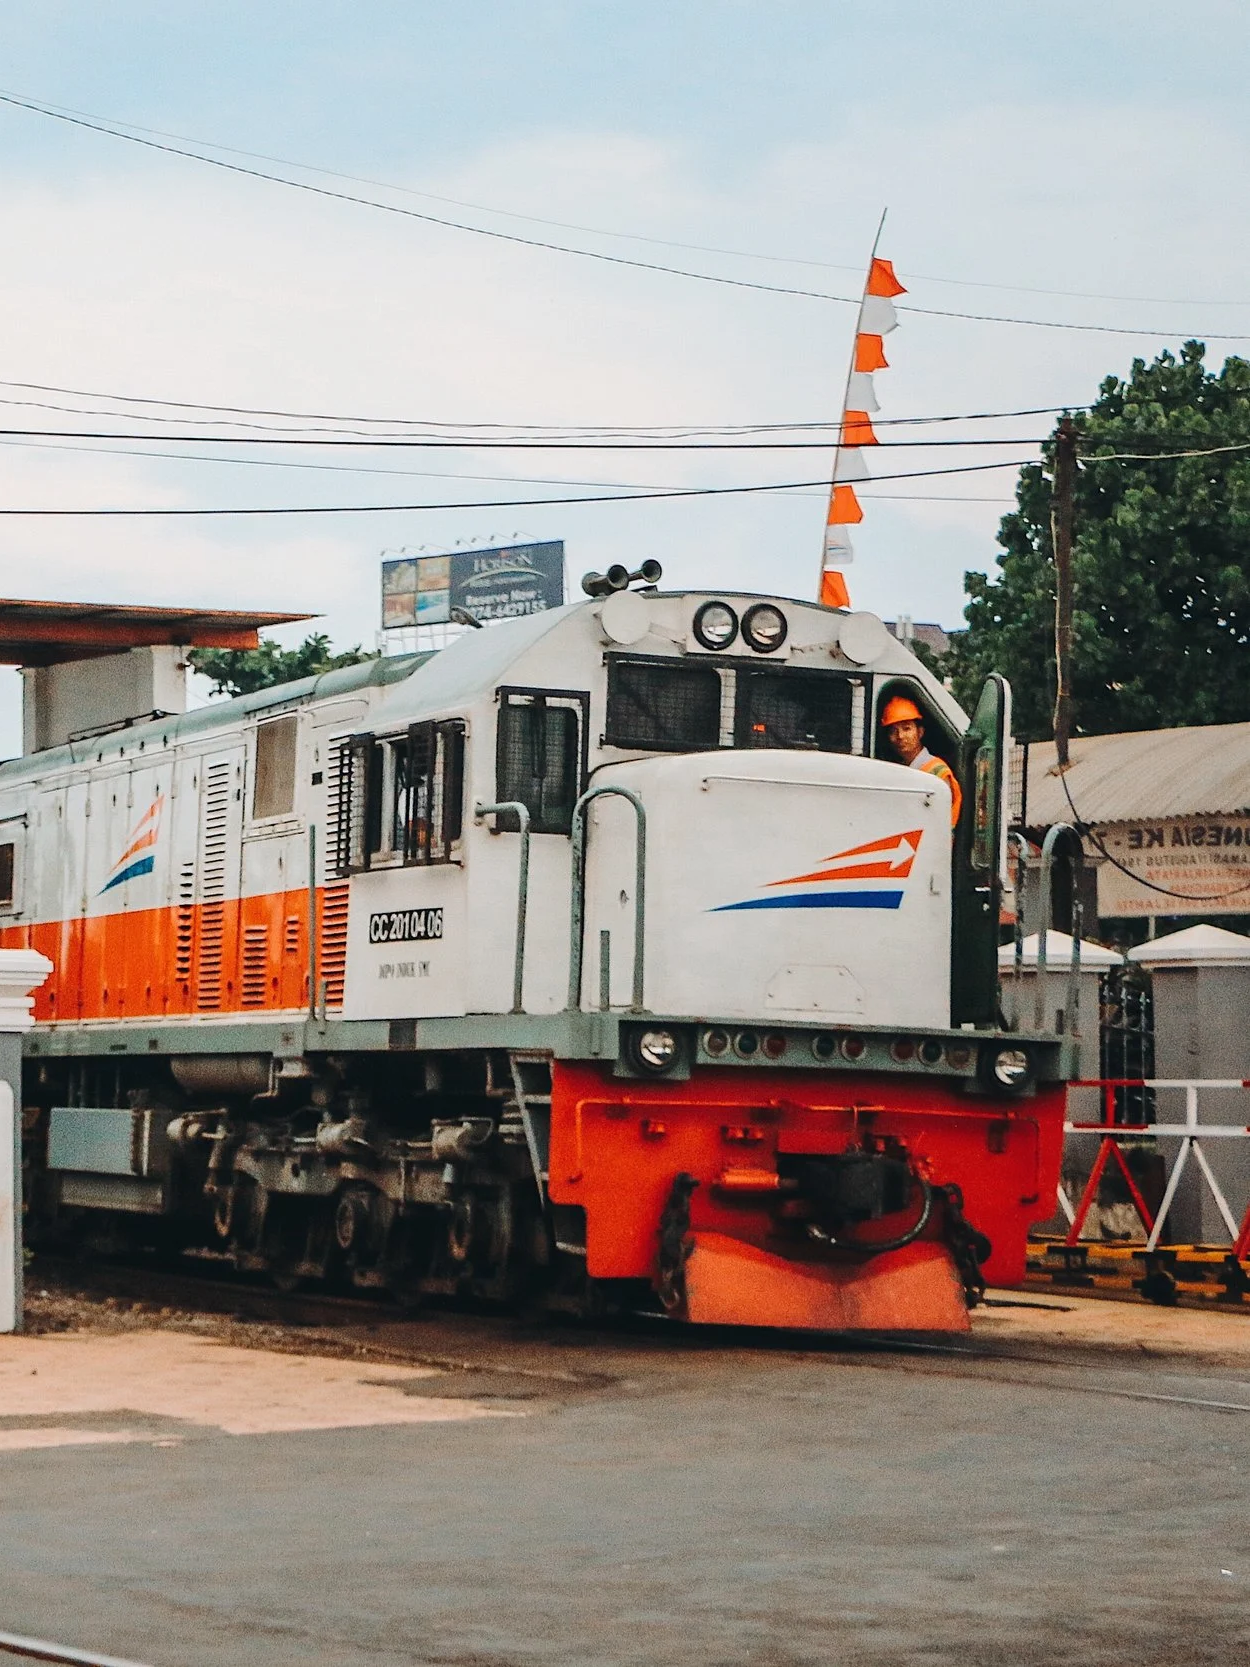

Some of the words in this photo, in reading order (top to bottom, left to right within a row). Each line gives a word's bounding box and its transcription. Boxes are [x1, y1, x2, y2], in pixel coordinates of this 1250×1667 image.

[370, 914, 389, 942] CC
[389, 912, 410, 940] 201
[410, 910, 426, 938] 04
[427, 909, 443, 938] 06
